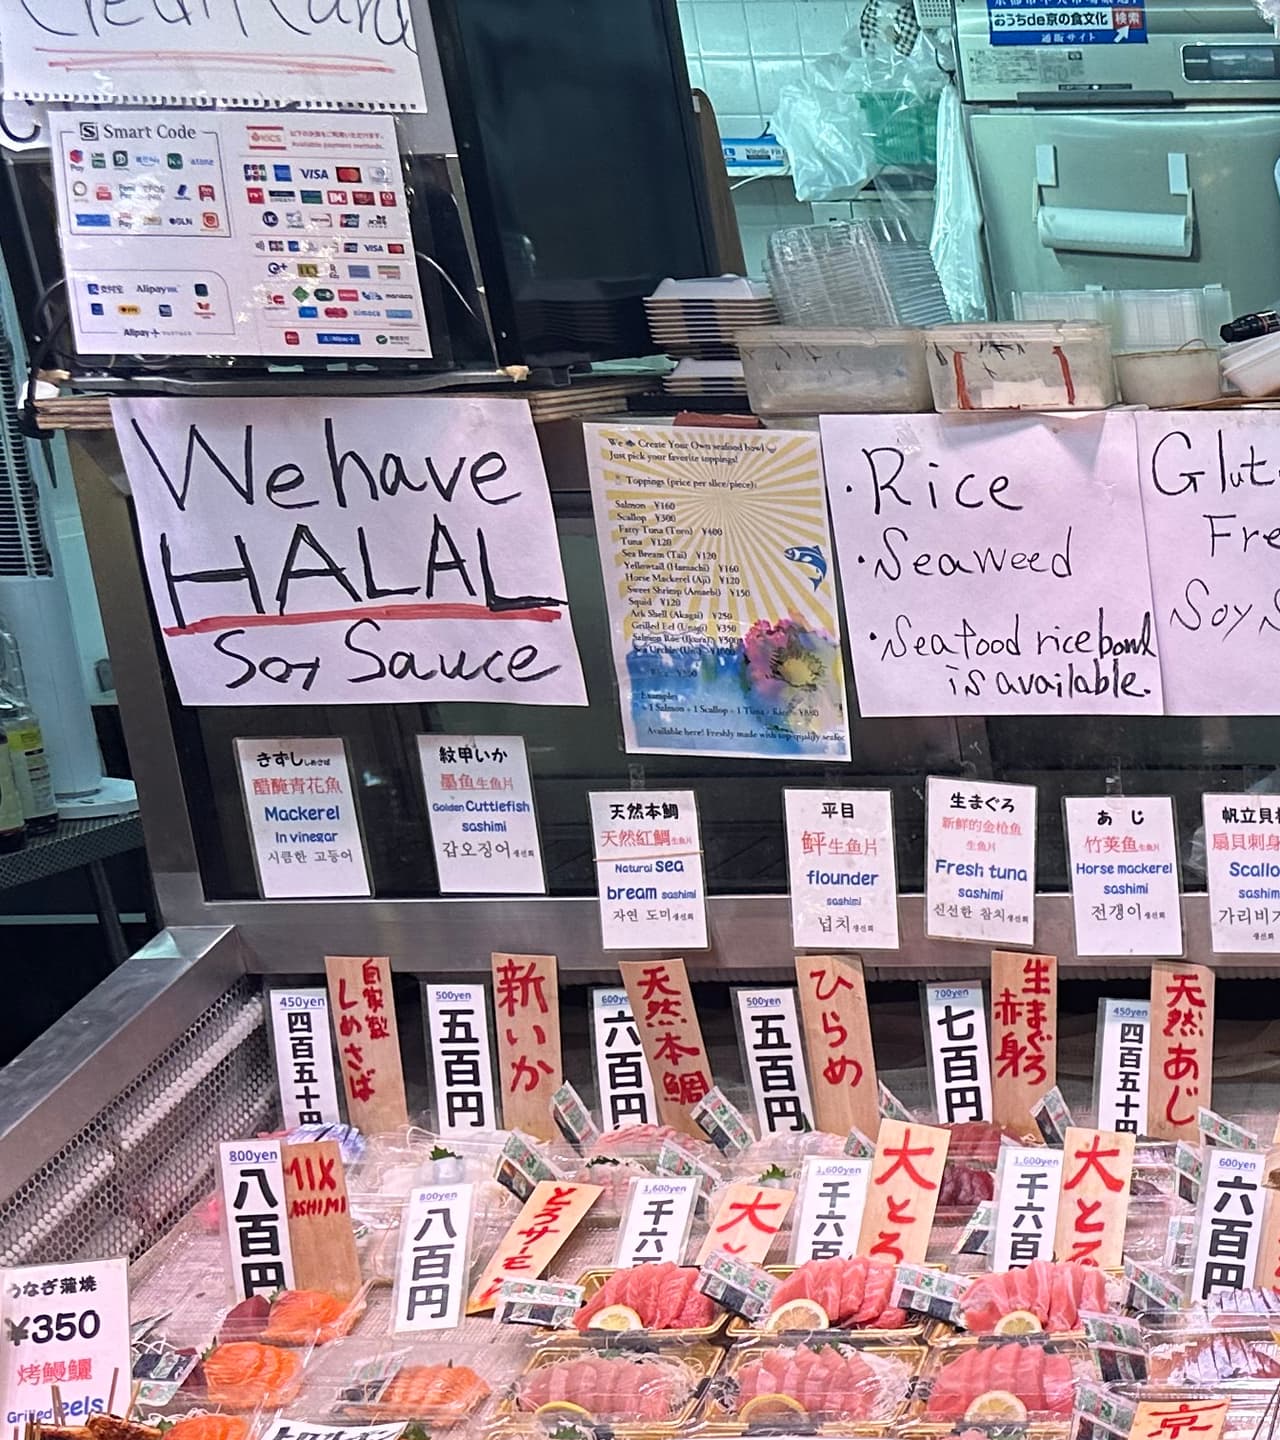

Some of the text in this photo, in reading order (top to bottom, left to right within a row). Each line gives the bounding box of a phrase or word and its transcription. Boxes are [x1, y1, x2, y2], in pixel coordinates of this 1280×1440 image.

[103, 126, 196, 139] Smart Code
[301, 168, 328, 180] VISA
[131, 418, 521, 509] We have
[626, 476, 664, 486] Toppings
[862, 446, 1023, 514] Rice
[617, 513, 647, 523] Scallop
[874, 525, 1074, 580] Seaweed
[161, 514, 569, 629] HALAL
[1170, 577, 1252, 640] Soy
[345, 619, 561, 684] Sauce
[439, 746, 508, 764] 紋甲いか
[466, 799, 530, 813] Cuttlefish
[609, 802, 679, 820] 天然本鯛
[821, 802, 855, 820] 平目
[950, 792, 1016, 814] 生まぐろ
[265, 805, 340, 823] Mackerel
[462, 820, 507, 834] sashimi
[290, 830, 338, 844] vinegar
[314, 848, 354, 863] 고등어
[615, 858, 684, 874] Natural sea
[935, 859, 1028, 881] Fresh tuna
[1075, 861, 1173, 876] Horse mackerel
[806, 869, 879, 887] flounder
[607, 884, 696, 900] bream sashimi
[958, 886, 1004, 901] sashimi
[1103, 882, 1149, 896] sashimi
[435, 990, 472, 1002] 500yen
[746, 996, 782, 1007] 500yen
[934, 987, 970, 999] 700yen
[278, 995, 326, 1009] 450yen
[1113, 1006, 1149, 1018] 450yen
[497, 961, 554, 1092] 新いか
[809, 969, 863, 1088] ひらめ
[1162, 974, 1206, 1126] 天然あじ
[439, 1008, 485, 1126] 五百円
[751, 1014, 803, 1134] 五百円
[228, 1149, 278, 1163] 800yen
[1218, 1157, 1257, 1171] 600yen
[419, 1190, 458, 1202] 800yen
[1202, 1175, 1258, 1300] 六百円
[407, 1208, 455, 1320] 八百円
[4, 1308, 101, 1347] ¥350
